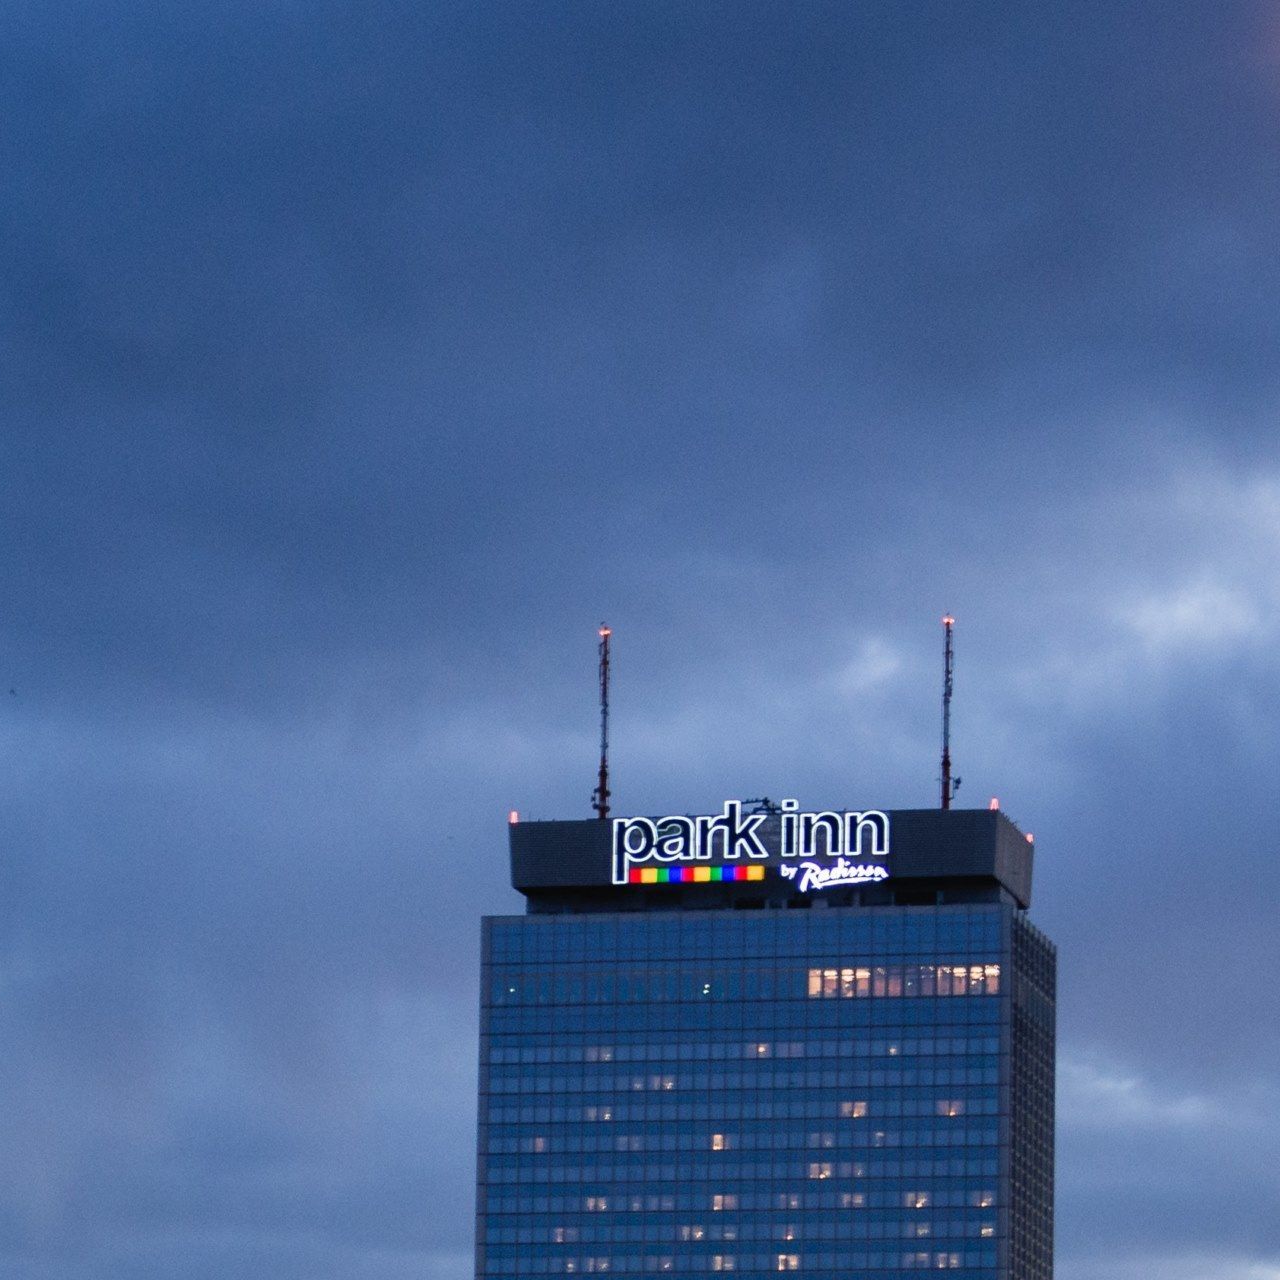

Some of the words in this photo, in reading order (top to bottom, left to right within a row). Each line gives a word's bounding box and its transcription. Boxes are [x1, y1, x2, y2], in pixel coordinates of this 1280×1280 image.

[612, 800, 768, 884] park
[781, 799, 889, 857] inn
[781, 864, 798, 880] by
[800, 858, 889, 892] Radisson
